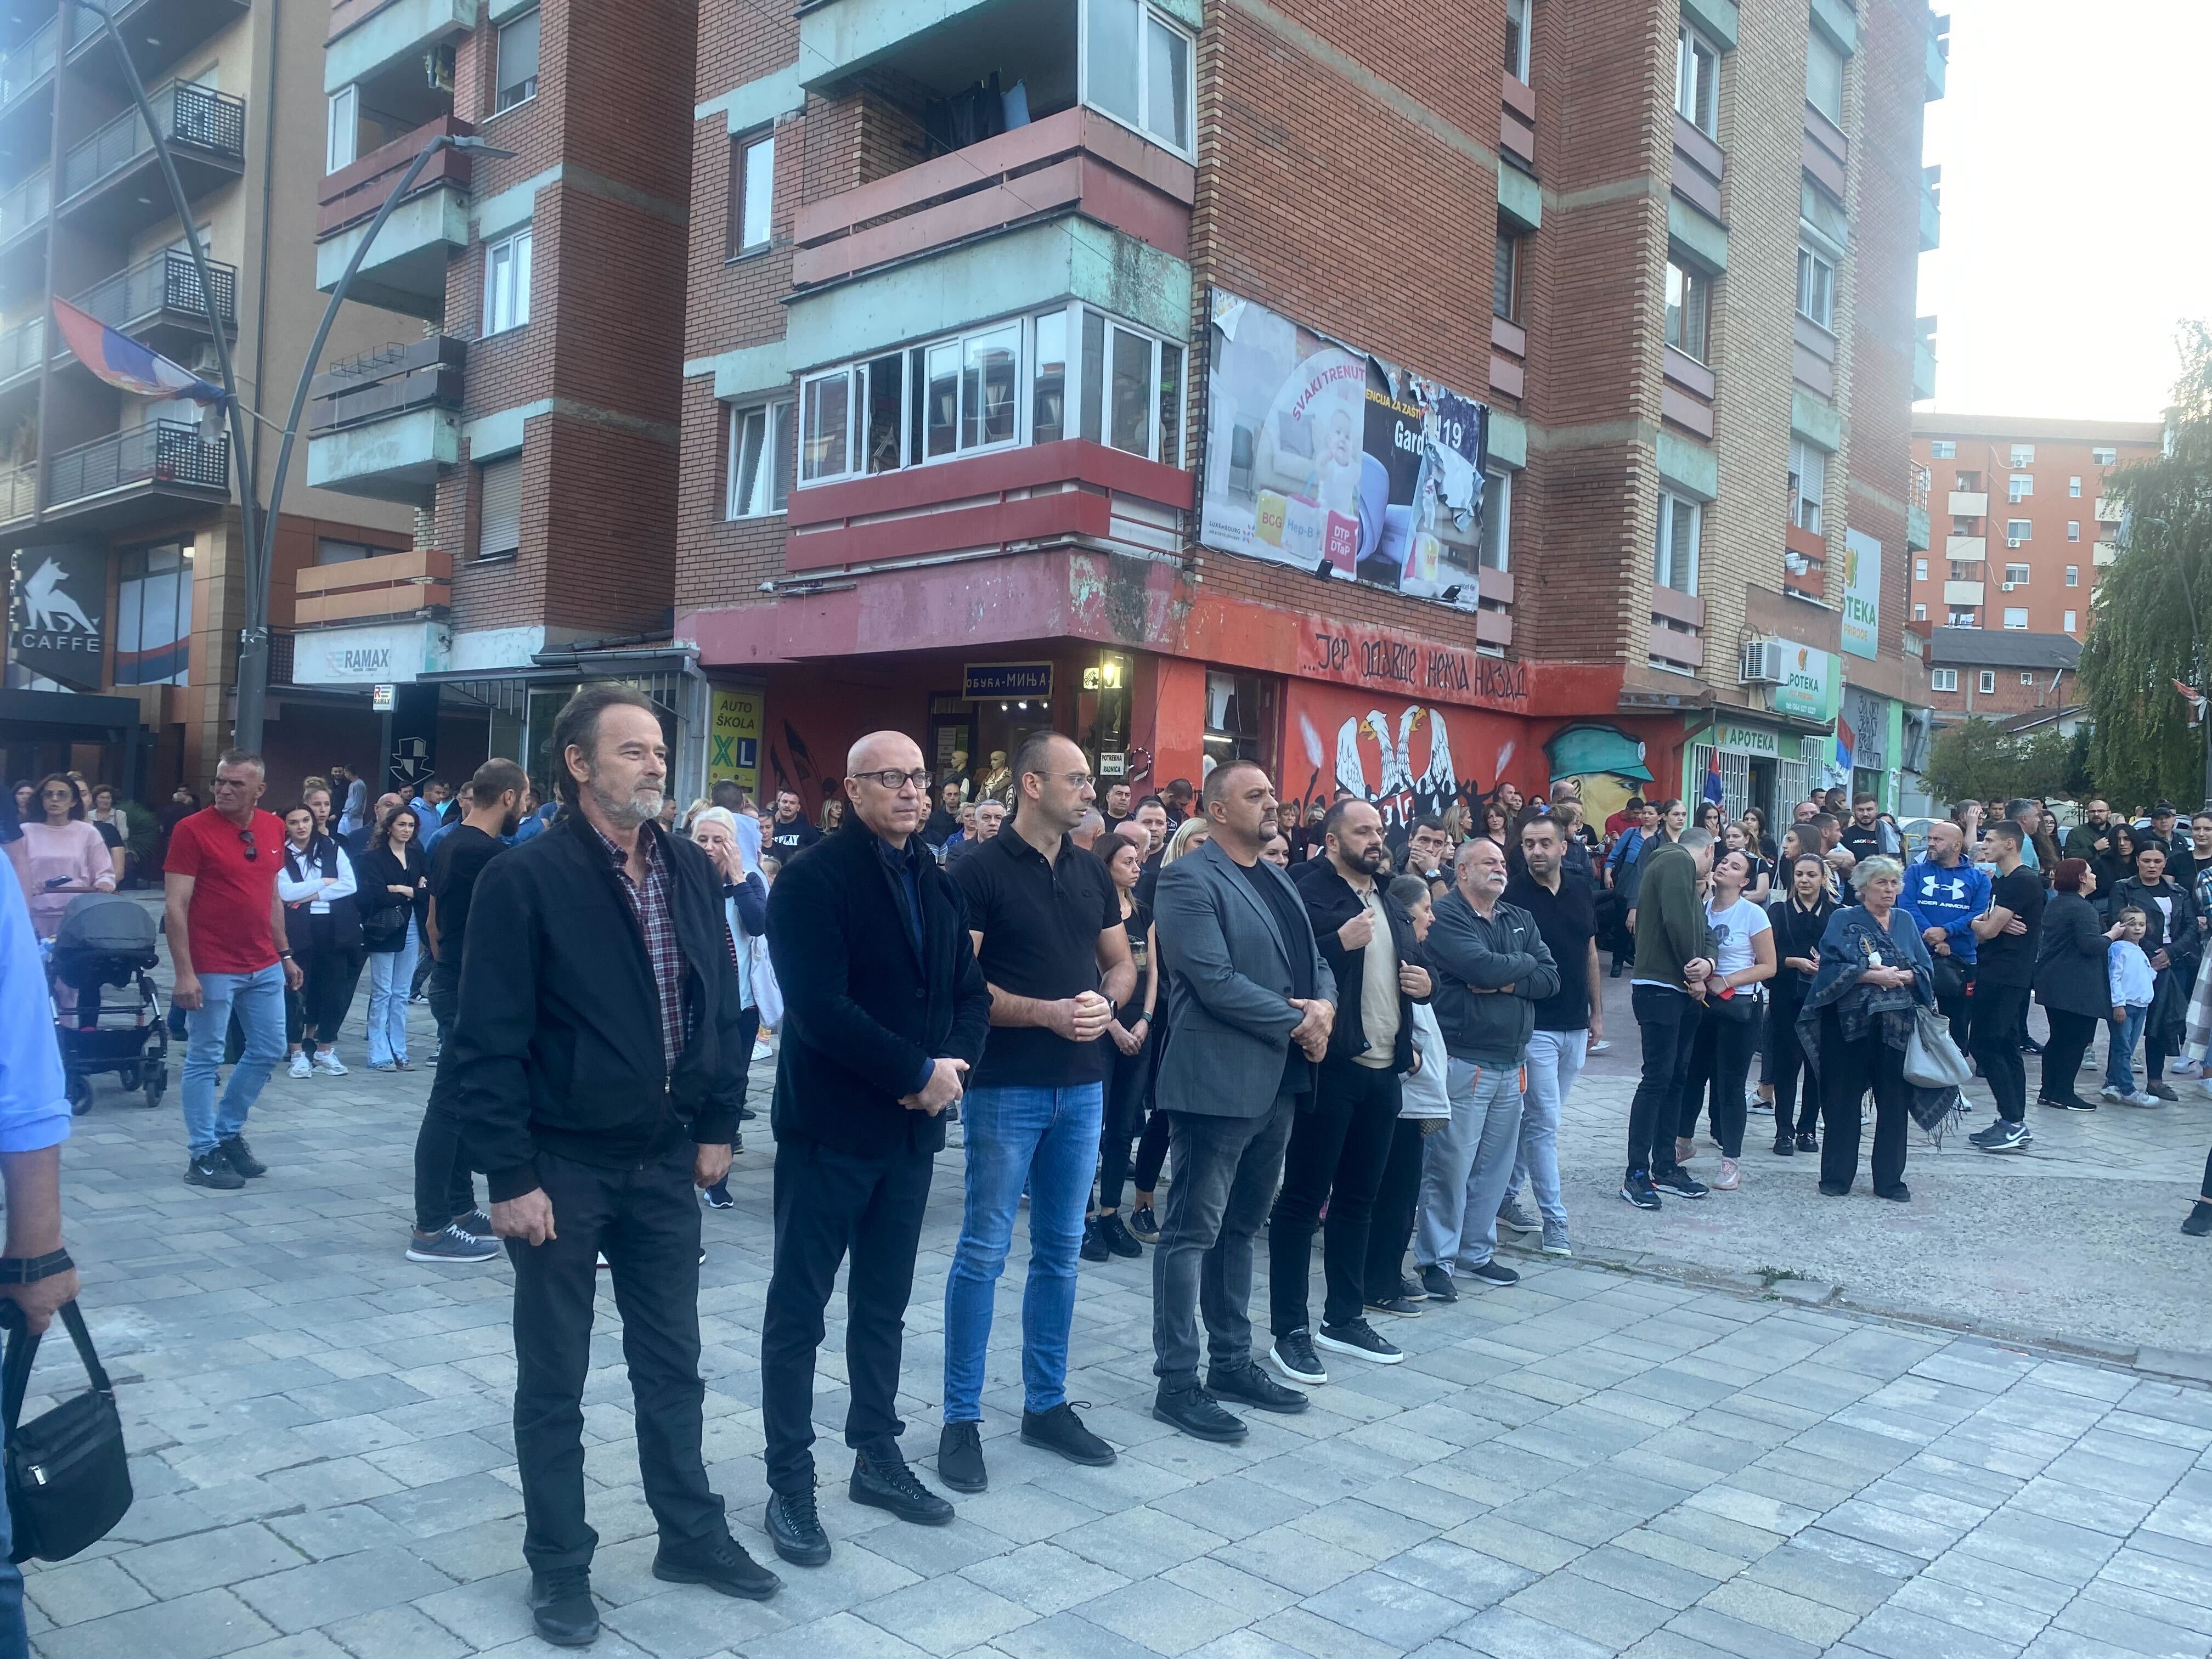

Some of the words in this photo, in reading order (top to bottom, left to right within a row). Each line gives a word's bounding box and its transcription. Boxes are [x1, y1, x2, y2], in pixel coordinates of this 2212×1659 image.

[1293, 376, 1323, 421] SVAKI
[1209, 520, 1240, 534] LUXEMBOURG
[1262, 512, 1283, 528] BCG
[1288, 518, 1313, 538] Hep-B
[1334, 526, 1350, 539] DTP
[1330, 541, 1350, 556] DTaP
[1843, 595, 1876, 627] TEKA
[21, 634, 100, 652] CAFFE
[345, 649, 390, 668] RAMAX
[1084, 670, 1097, 686] BUTIK
[1788, 673, 1819, 692] POTEKA
[720, 699, 753, 713] AUTO
[716, 713, 755, 730] ŠKOLA
[1729, 728, 1774, 752] APOTEKA
[772, 834, 799, 845] EPLAY
[1939, 902, 1970, 910] ARMOUR
